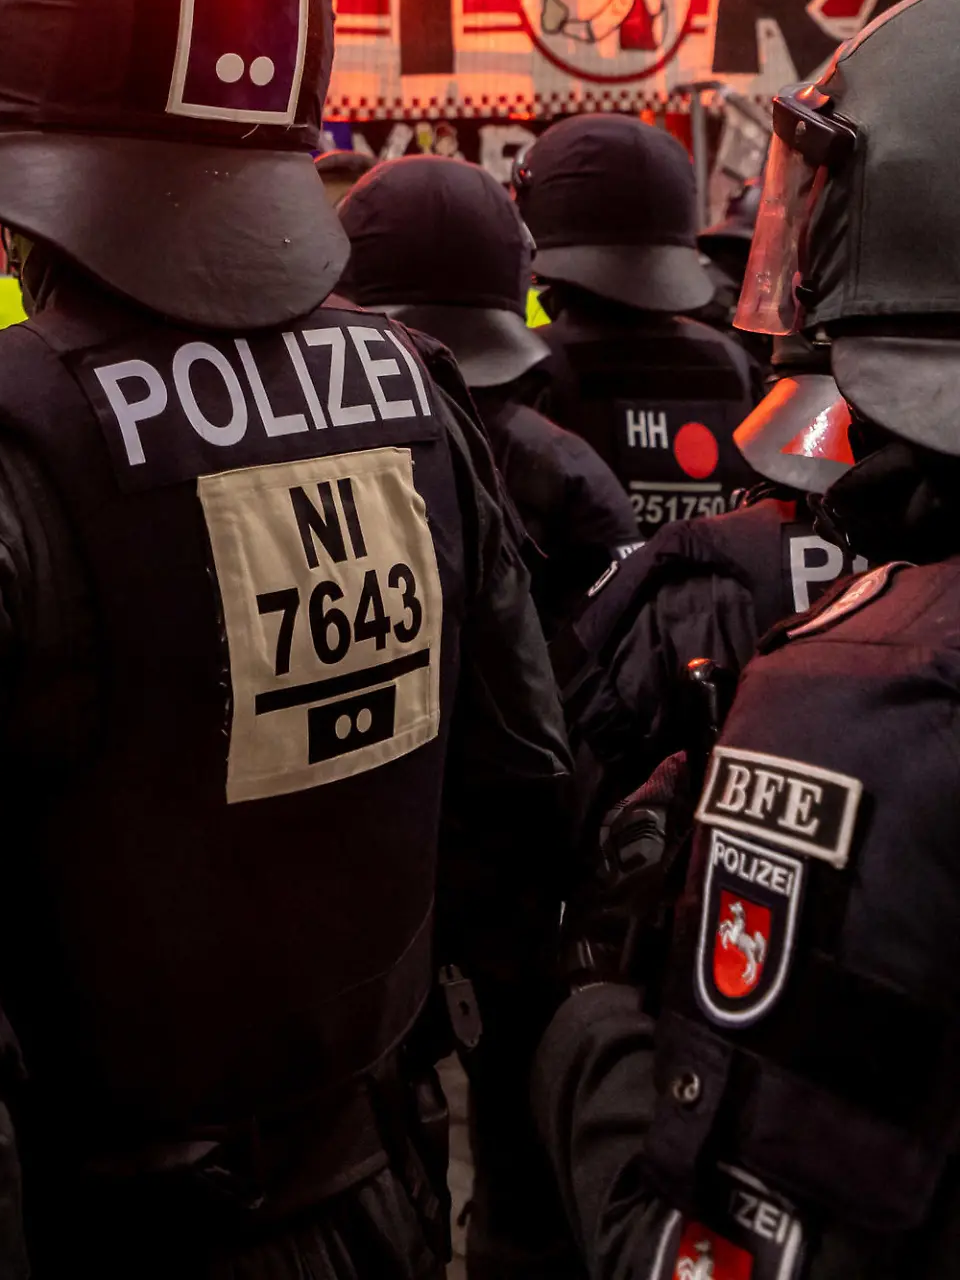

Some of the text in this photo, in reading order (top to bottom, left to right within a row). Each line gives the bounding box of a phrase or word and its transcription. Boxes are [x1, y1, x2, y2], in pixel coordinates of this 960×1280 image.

[94, 326, 431, 466] POLIZEI
[626, 409, 669, 450] HH
[289, 477, 368, 570] NI
[629, 493, 726, 524] 251750
[256, 562, 423, 677] 7643
[716, 764, 823, 838] BFE
[713, 841, 795, 897] POLIZEI
